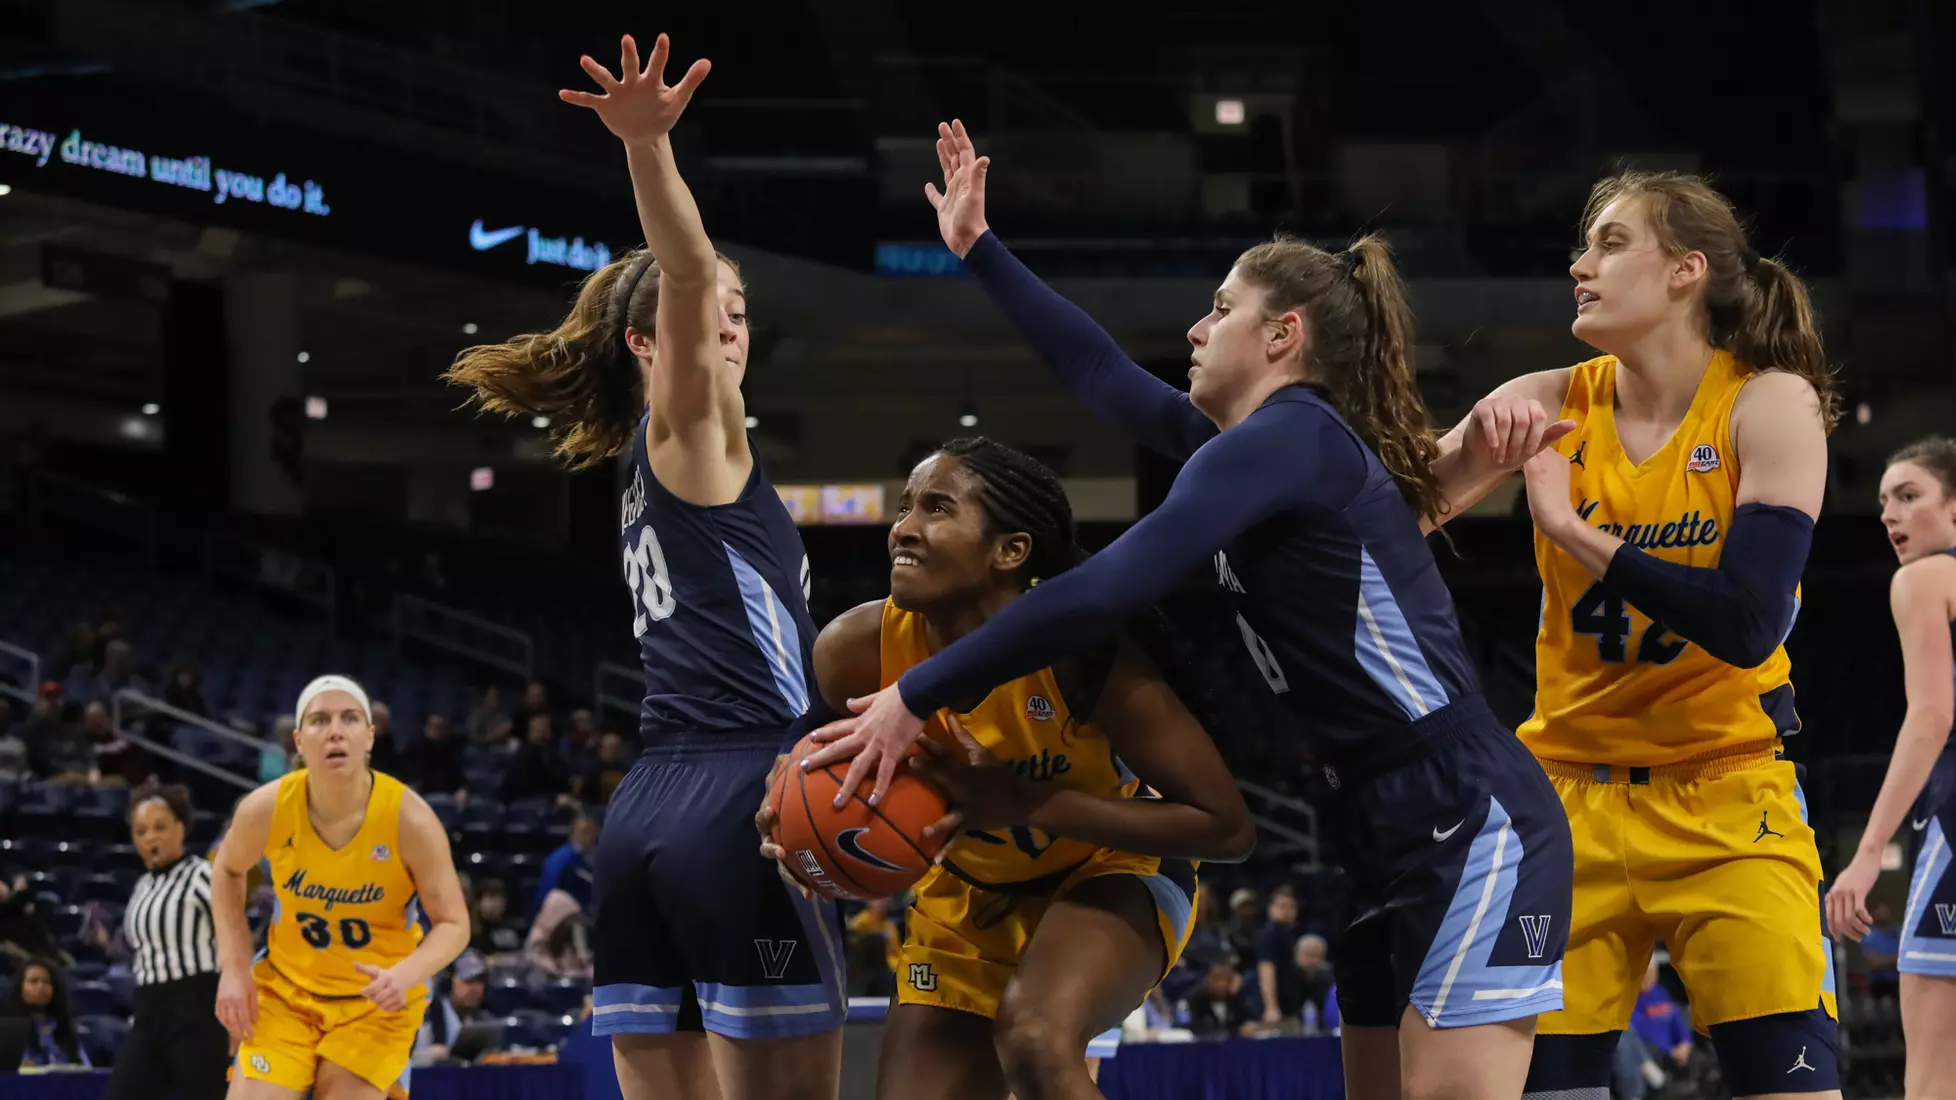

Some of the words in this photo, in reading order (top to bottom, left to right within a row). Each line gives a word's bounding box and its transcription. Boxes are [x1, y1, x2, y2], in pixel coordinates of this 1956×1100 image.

[61, 129, 147, 177] dream
[150, 156, 211, 191] until
[214, 168, 264, 204] you
[266, 173, 301, 209] do
[303, 179, 330, 216] it.
[1694, 447, 1711, 460] 40
[283, 867, 385, 911] Marquette
[296, 911, 372, 949] 30
[1518, 914, 1551, 958] V
[754, 938, 797, 979] V
[909, 963, 938, 992] MU
